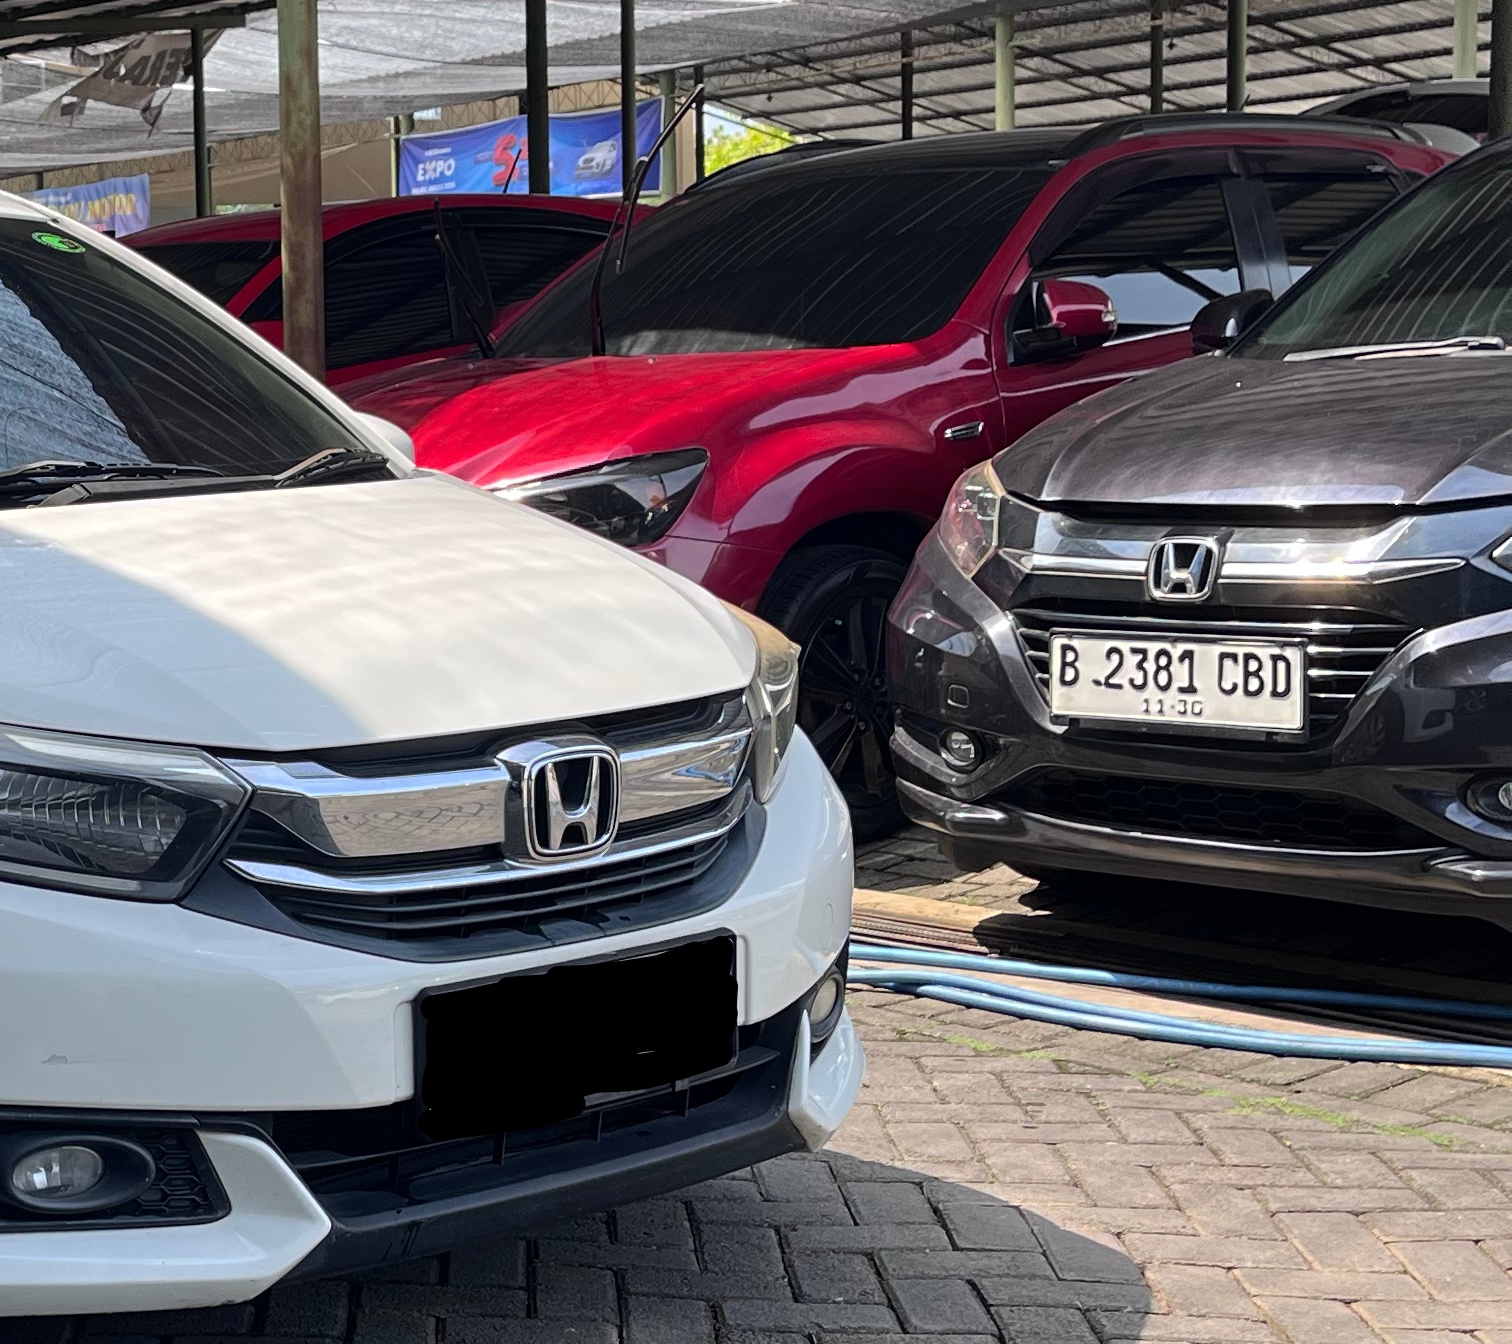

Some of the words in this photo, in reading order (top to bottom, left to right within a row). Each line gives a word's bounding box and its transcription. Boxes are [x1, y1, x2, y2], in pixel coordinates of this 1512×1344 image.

[416, 158, 456, 182] EXPO
[1059, 643, 1080, 688] B
[1103, 645, 1198, 694] 2381
[1217, 650, 1292, 699] CBD
